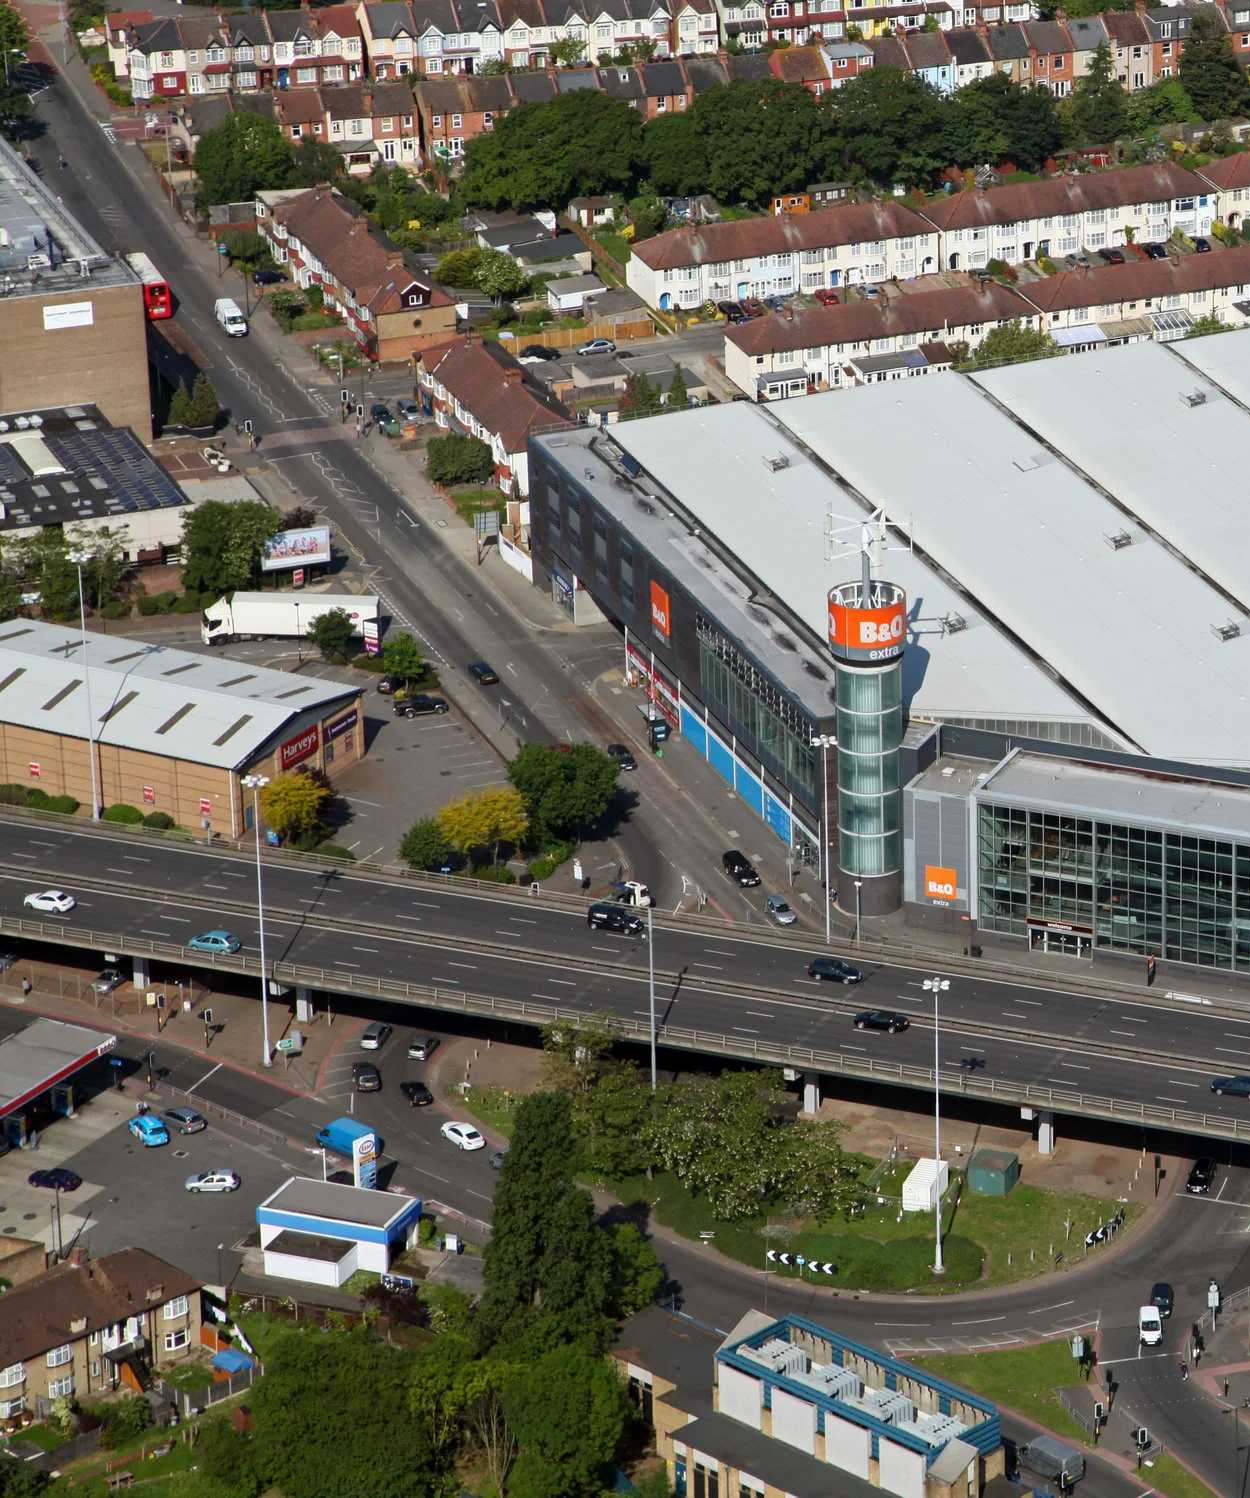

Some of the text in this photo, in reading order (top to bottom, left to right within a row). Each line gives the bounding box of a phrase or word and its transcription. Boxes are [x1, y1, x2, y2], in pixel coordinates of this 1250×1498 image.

[859, 615, 903, 643] B&Q
[869, 645, 899, 660] extra
[283, 732, 317, 760] Harveys
[928, 881, 954, 897] B&Q
[932, 899, 950, 907] extra
[1047, 922, 1073, 931] welcome
